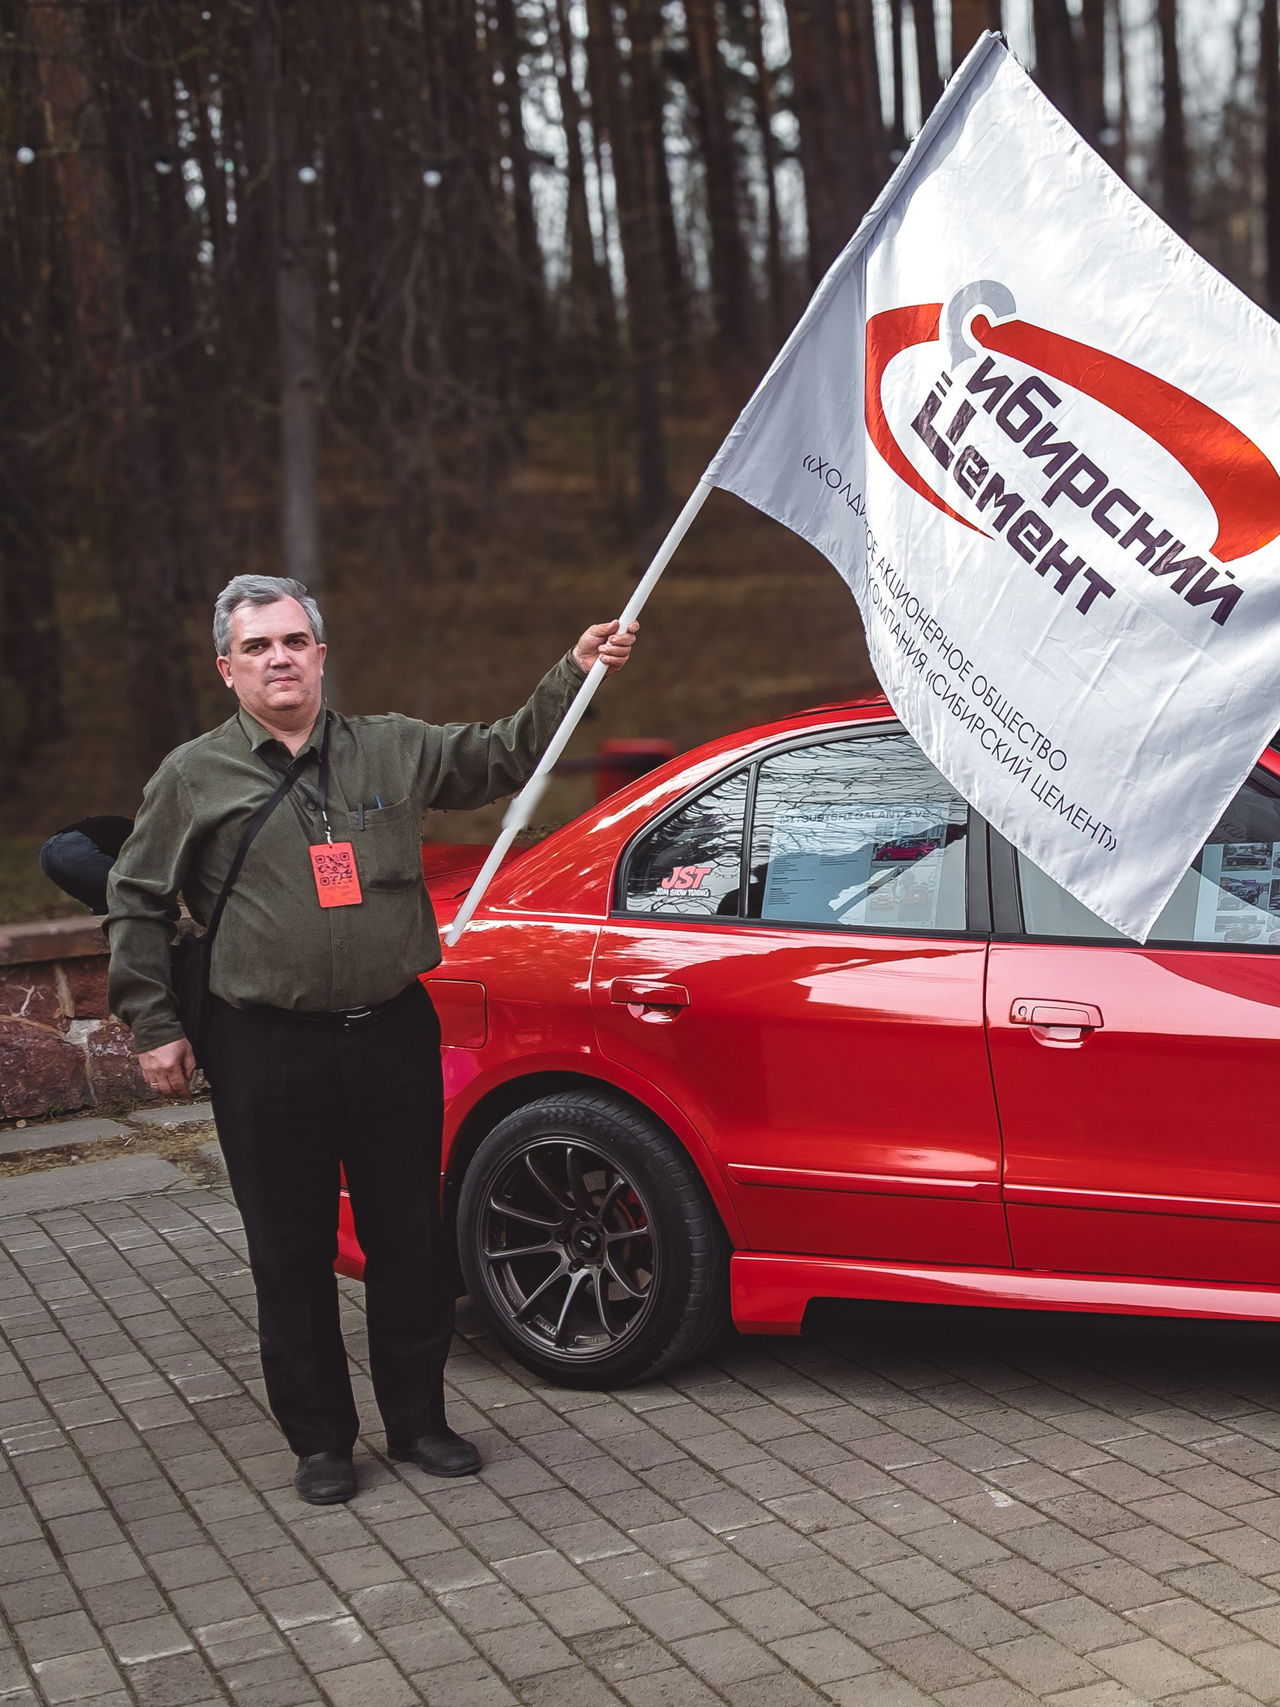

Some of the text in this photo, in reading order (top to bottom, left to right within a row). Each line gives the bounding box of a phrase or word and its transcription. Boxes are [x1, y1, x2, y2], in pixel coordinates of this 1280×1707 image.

[876, 556, 974, 682] АКЦИОНЕРНОЕ
[971, 674, 1068, 772] ОБЩЕСТВО
[925, 669, 1033, 783] «СИБИРСКИЙ
[1030, 773, 1118, 852] ЦЕМЕНТ»
[661, 865, 712, 889] JST
